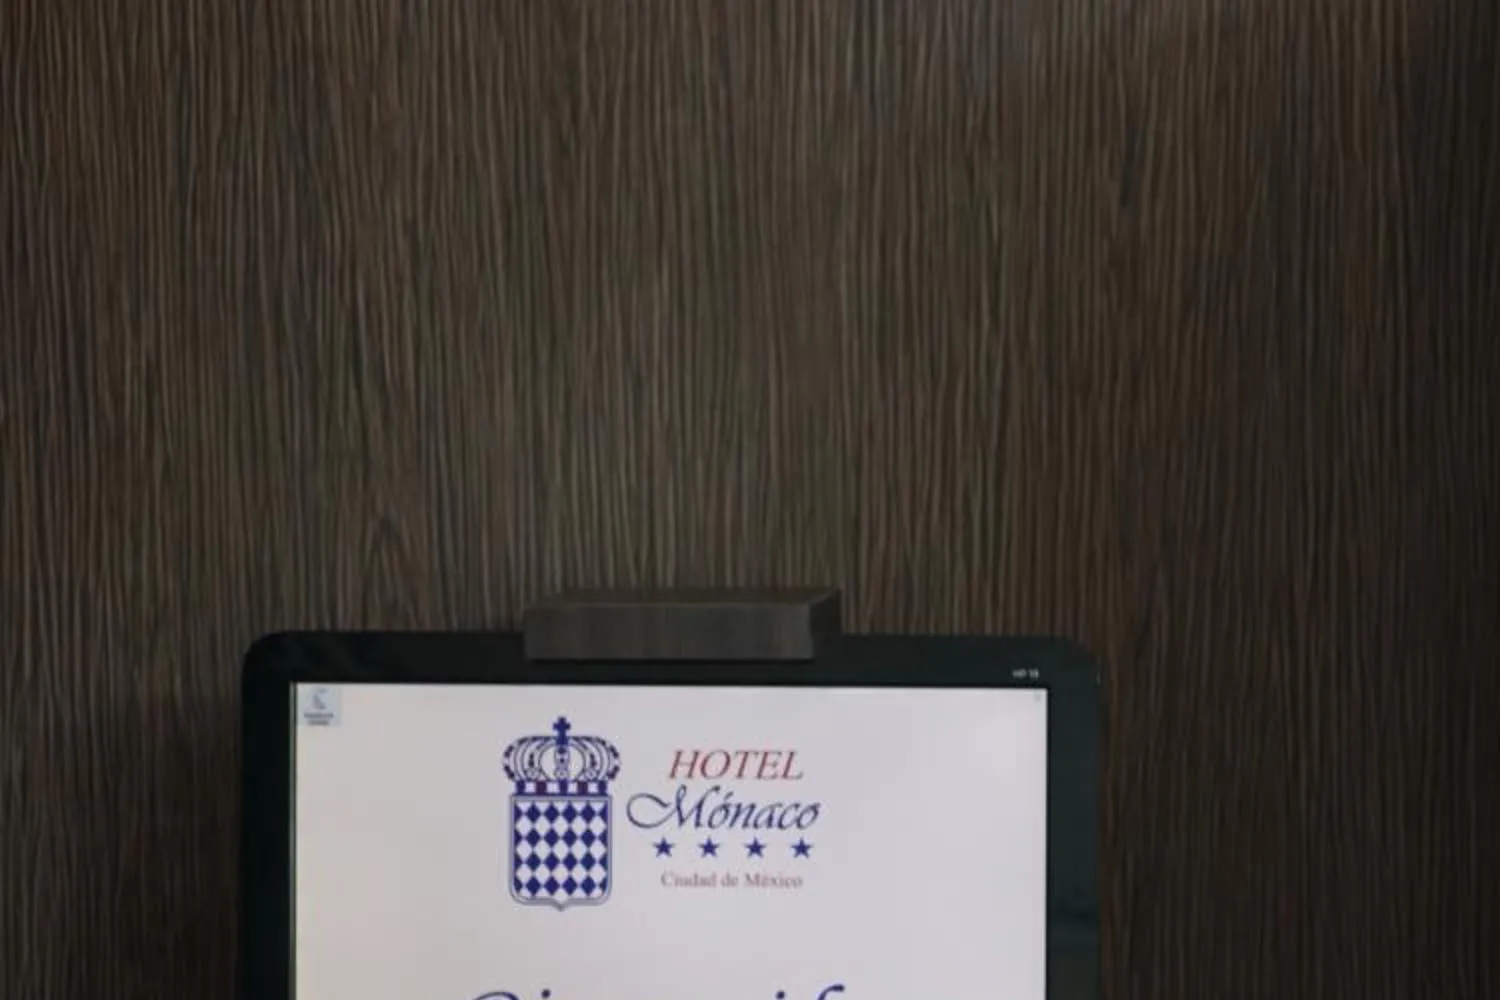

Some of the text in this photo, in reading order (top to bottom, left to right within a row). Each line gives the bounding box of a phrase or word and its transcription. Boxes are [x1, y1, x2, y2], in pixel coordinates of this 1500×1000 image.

[669, 749, 804, 780] HOTEL
[626, 784, 822, 830] Mónaco
[660, 871, 803, 888] Ciudad de México
